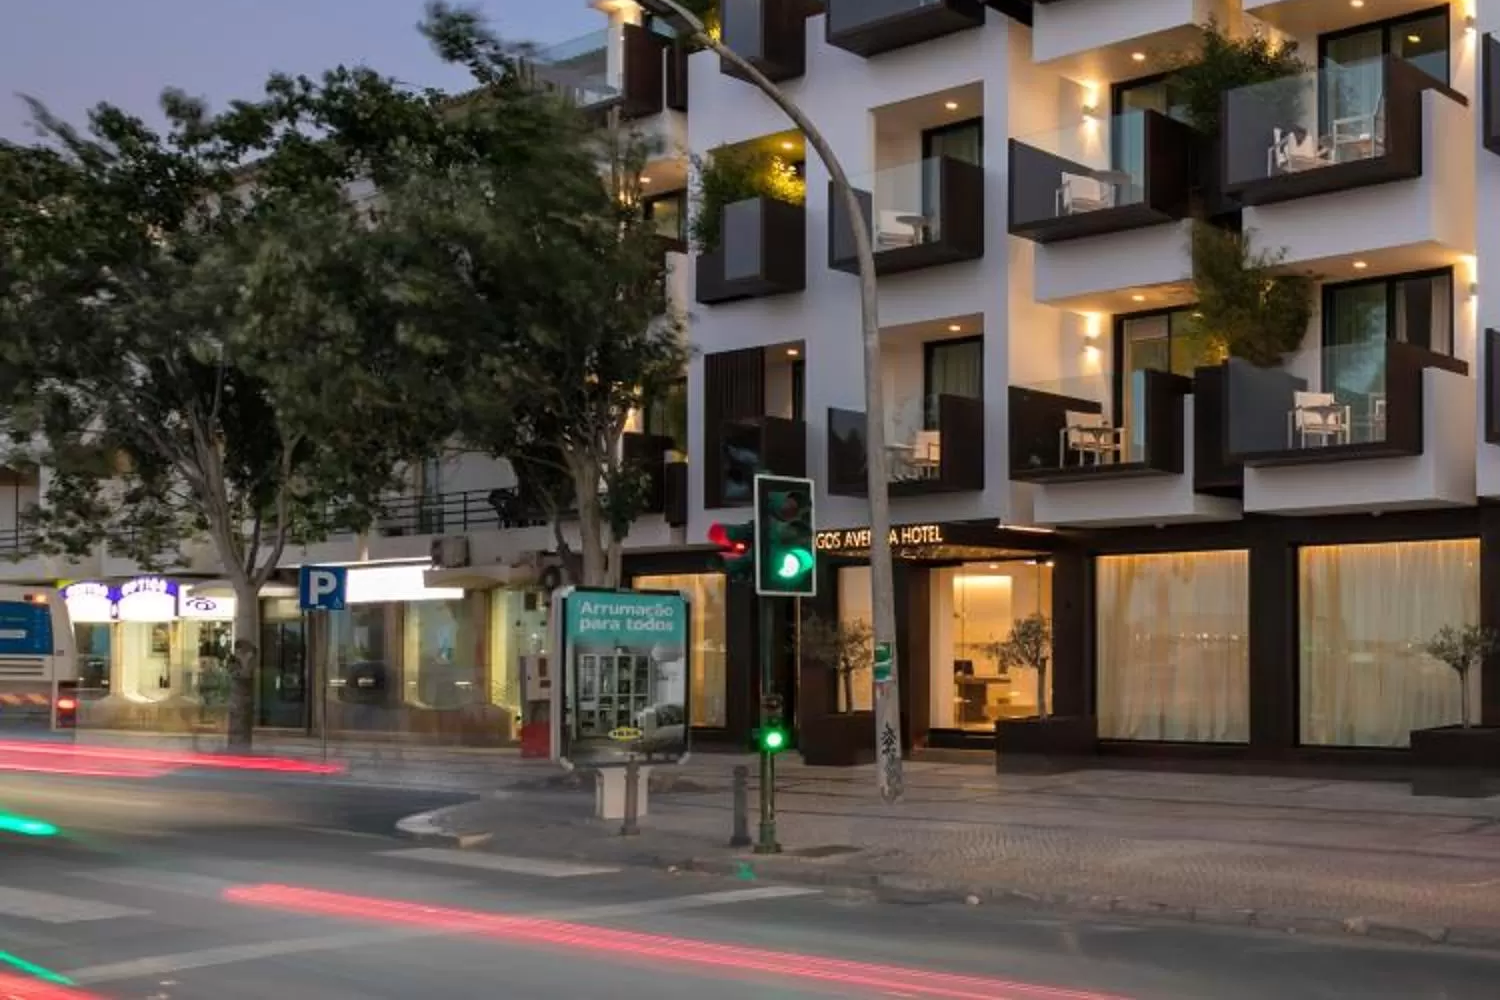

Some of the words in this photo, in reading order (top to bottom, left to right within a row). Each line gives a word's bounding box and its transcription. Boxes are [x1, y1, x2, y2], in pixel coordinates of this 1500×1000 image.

[815, 531, 841, 549] GOS
[843, 528, 898, 548] AVEA
[901, 525, 943, 545] HOTEL
[309, 571, 337, 605] P
[581, 600, 674, 617] Arrumação
[580, 618, 620, 632] para
[626, 617, 673, 632] todos
